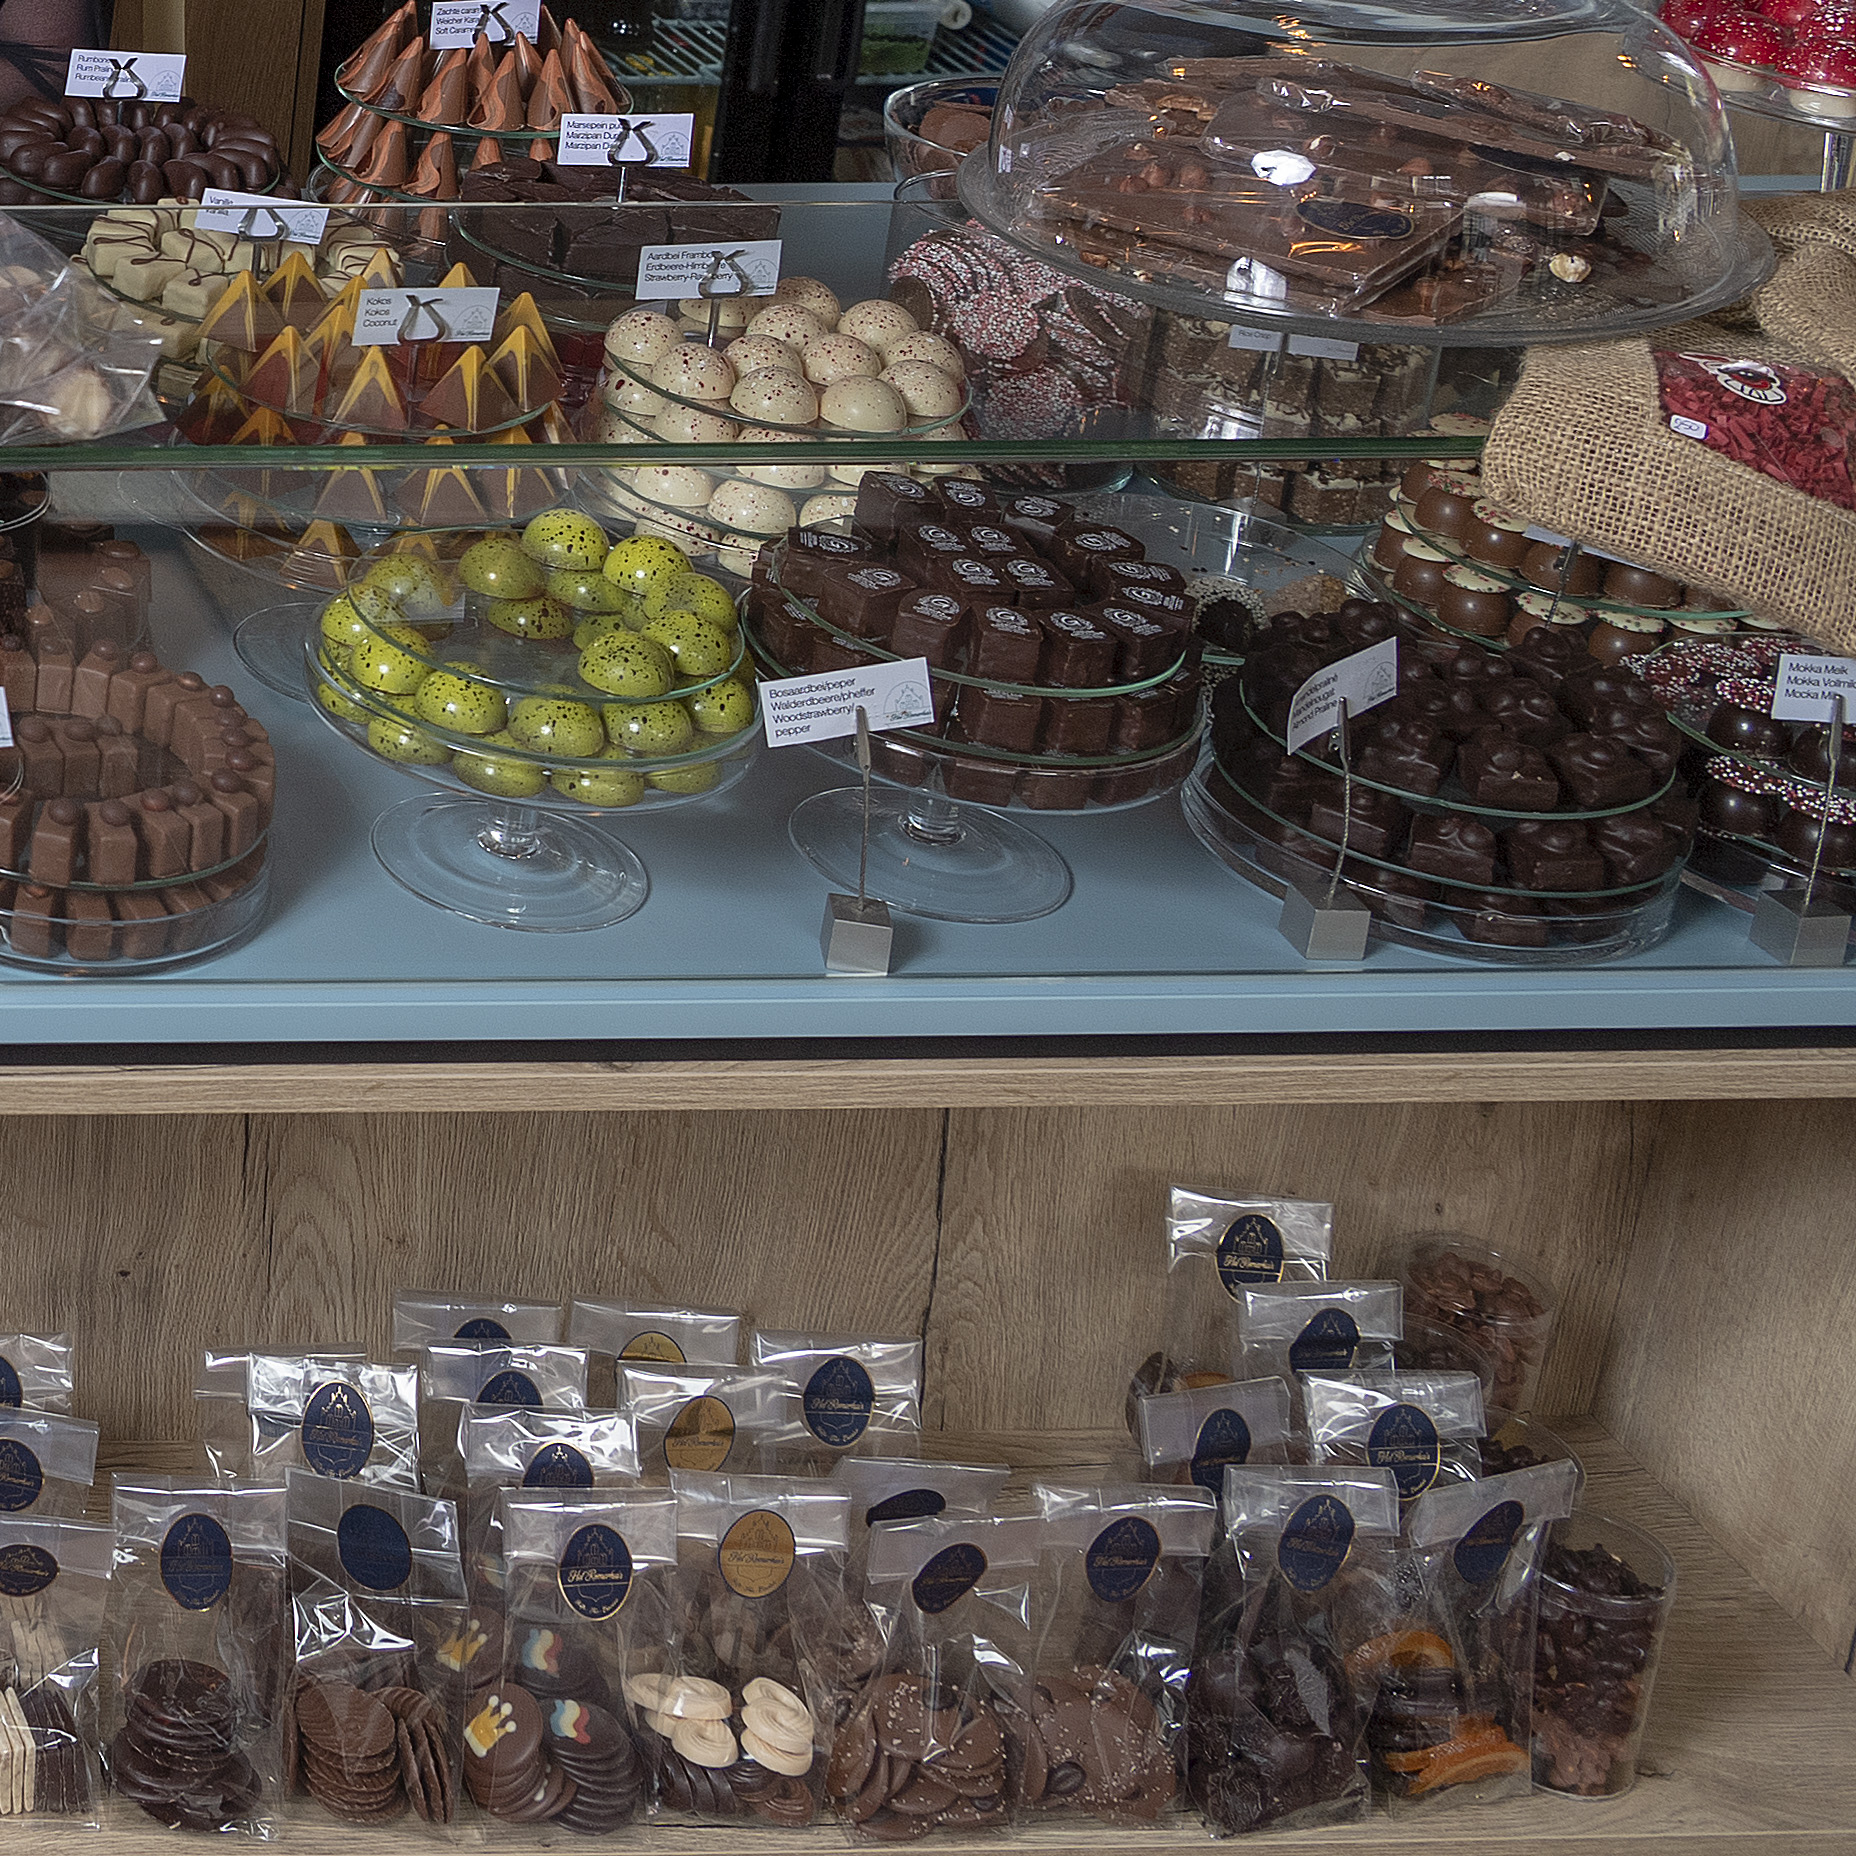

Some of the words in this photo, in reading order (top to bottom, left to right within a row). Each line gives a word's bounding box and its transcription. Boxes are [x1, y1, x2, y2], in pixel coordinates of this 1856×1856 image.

[567, 121, 606, 132] Marsepein
[566, 132, 602, 142] Marzipan
[565, 142, 601, 151] Marzipan
[647, 251, 680, 261] Aardbei
[367, 297, 391, 305] Kokos
[365, 308, 390, 316] Kokos
[362, 319, 399, 327] Coconut
[1789, 663, 1822, 673] Mokka
[1787, 676, 1820, 686] Mokka
[770, 677, 856, 697] Bosaardbei/peper
[775, 724, 812, 739] pepper
